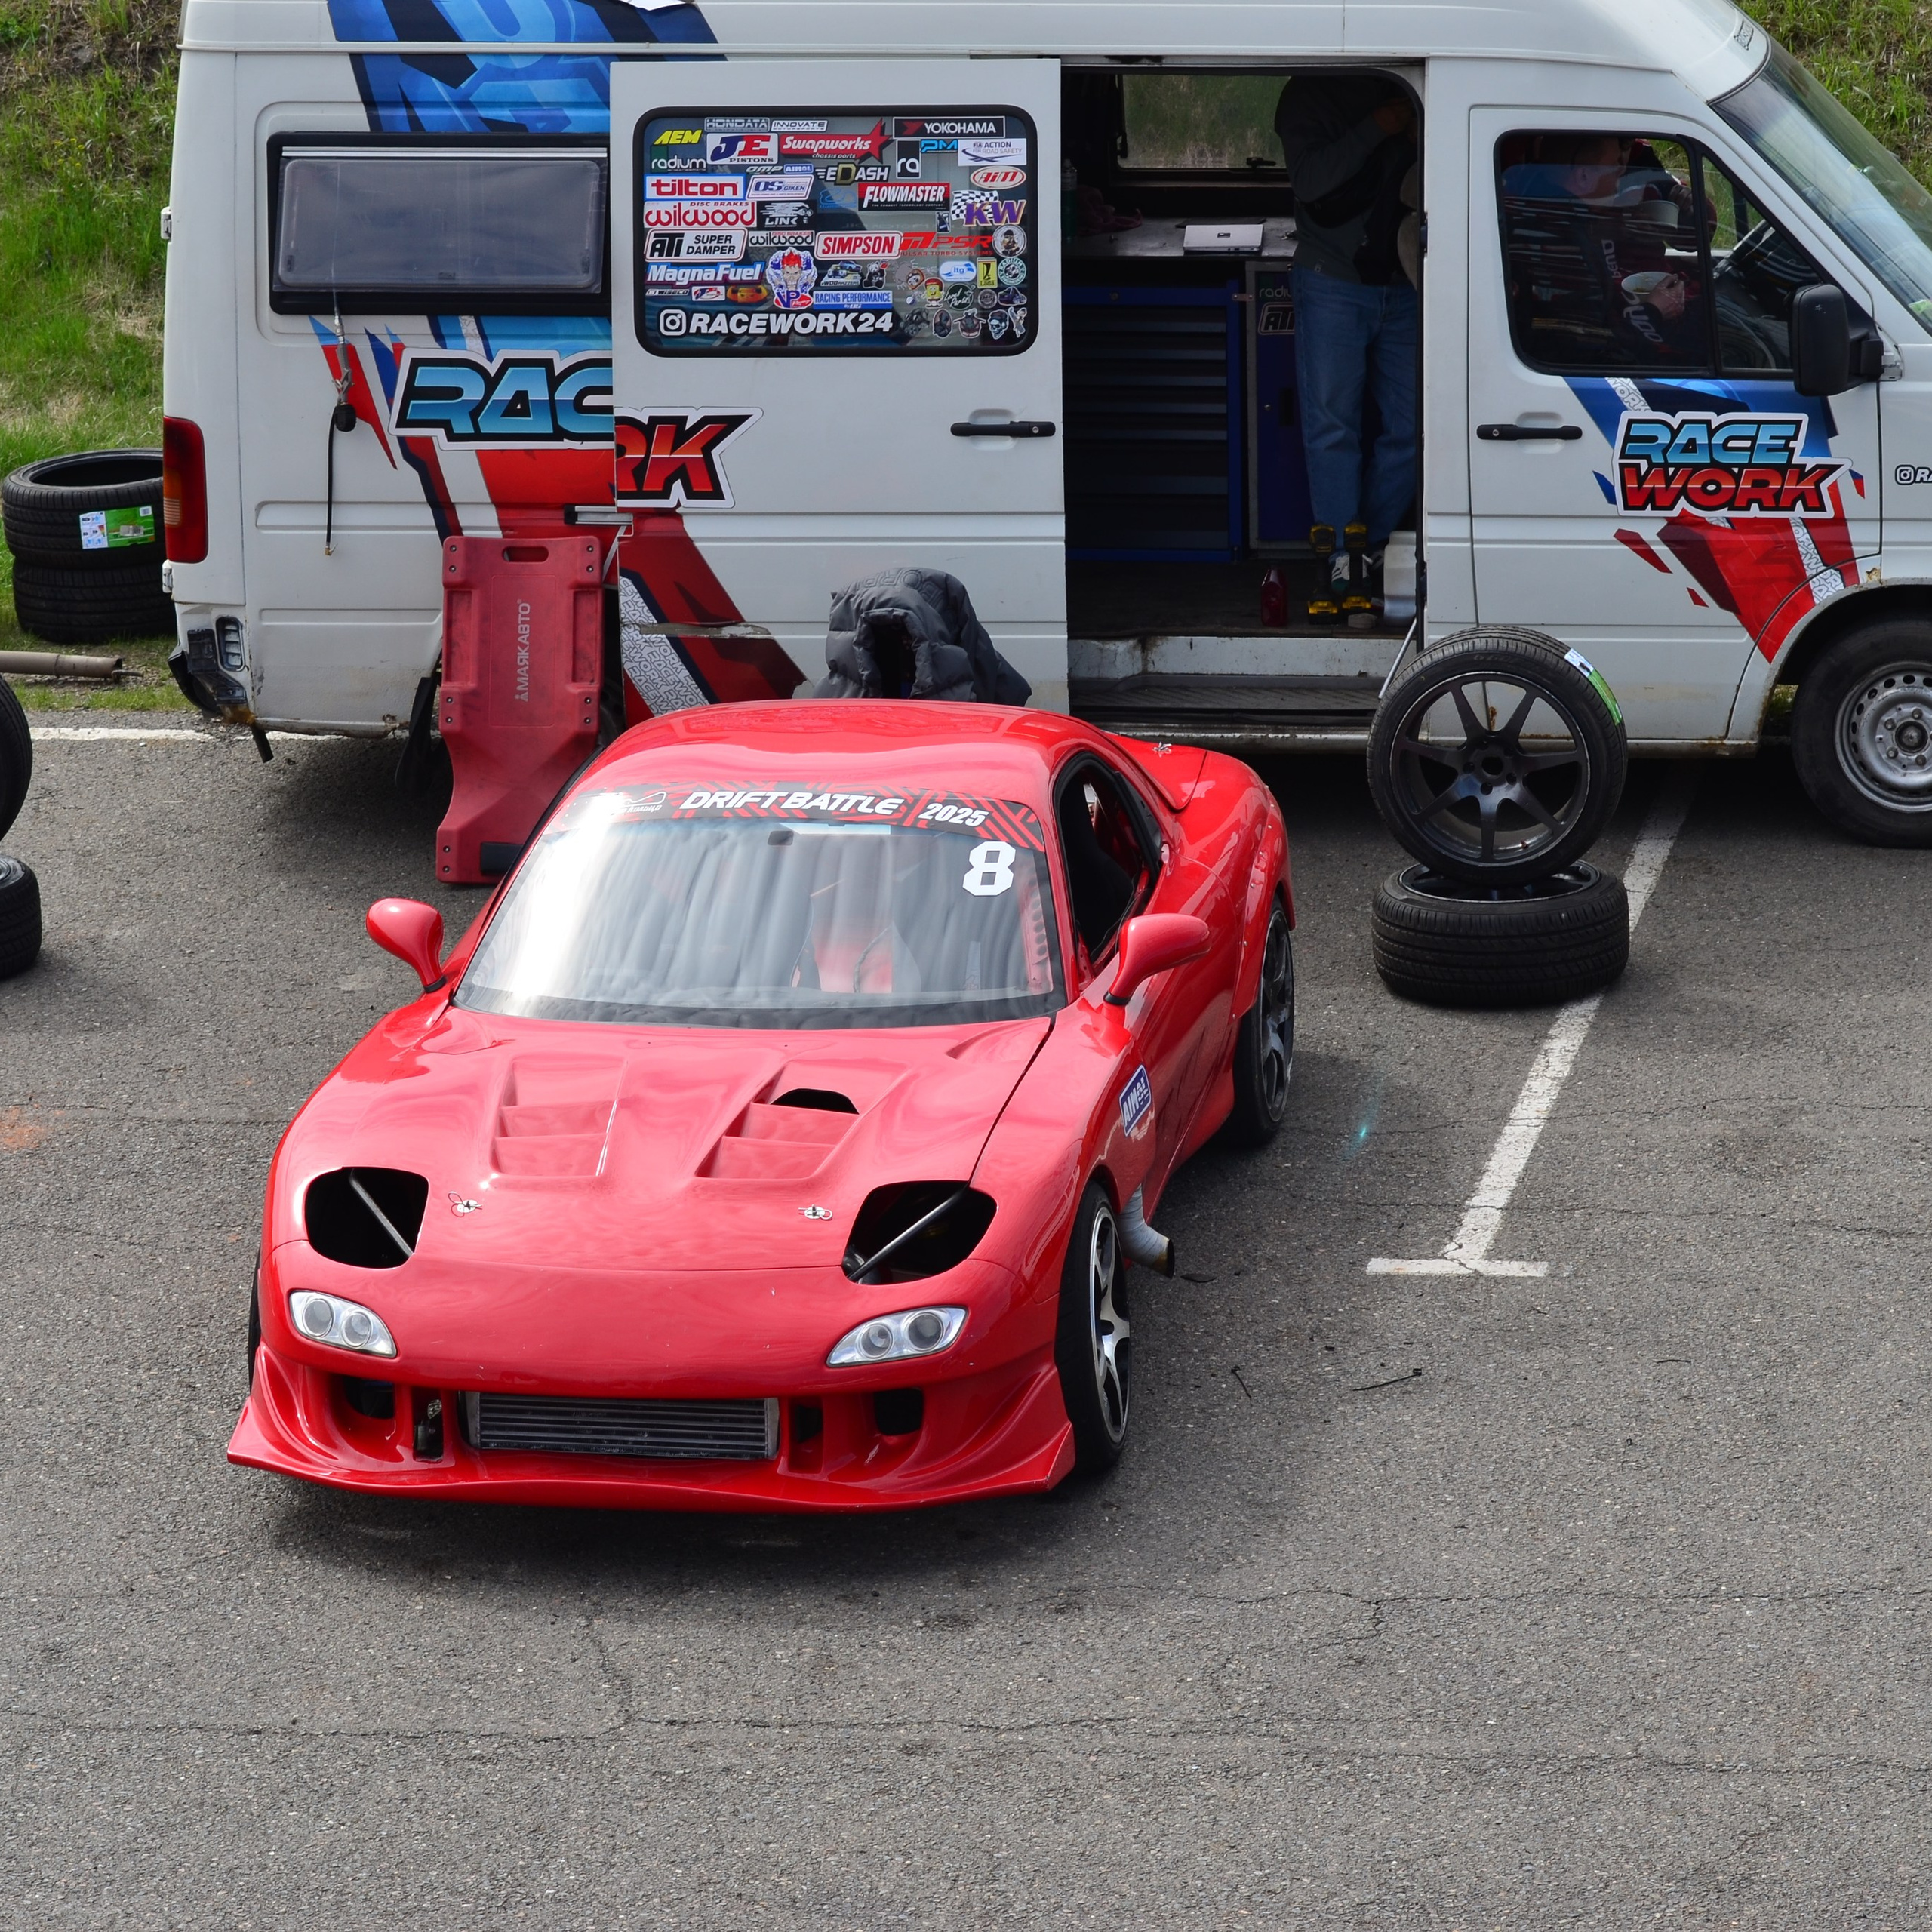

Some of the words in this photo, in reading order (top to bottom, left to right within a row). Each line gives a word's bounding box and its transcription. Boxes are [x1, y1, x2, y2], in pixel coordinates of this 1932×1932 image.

[706, 118, 768, 128] HONDATA
[924, 122, 997, 134] YOKOHAMA
[654, 129, 703, 145] AEM
[783, 136, 872, 153] Swapworks
[710, 135, 771, 162] JE
[651, 155, 706, 169] radium
[651, 179, 738, 195] tilton
[863, 186, 946, 208] FLOWMASTER
[645, 202, 755, 226] wilwood
[964, 202, 1026, 226] KW
[694, 235, 732, 244] SUPER
[749, 232, 814, 245] wilwood
[822, 237, 895, 254] SIMPSON
[686, 246, 735, 254] DAMPER
[647, 263, 762, 285] MagnaFuel
[776, 291, 800, 308] VP
[815, 294, 840, 303] RACING
[842, 293, 891, 303] PERFORMANCE
[1259, 285, 1293, 297] radiu
[690, 312, 893, 334] RACEWORK24
[406, 366, 614, 434] RAC
[1625, 424, 1796, 463] RACE
[1623, 468, 1829, 507] WORK
[516, 602, 531, 694] МАЯКАВТО
[680, 792, 787, 809] DRIFT
[780, 792, 905, 815] BATTLE
[918, 803, 989, 827] 2025
[962, 841, 1017, 897] 8
